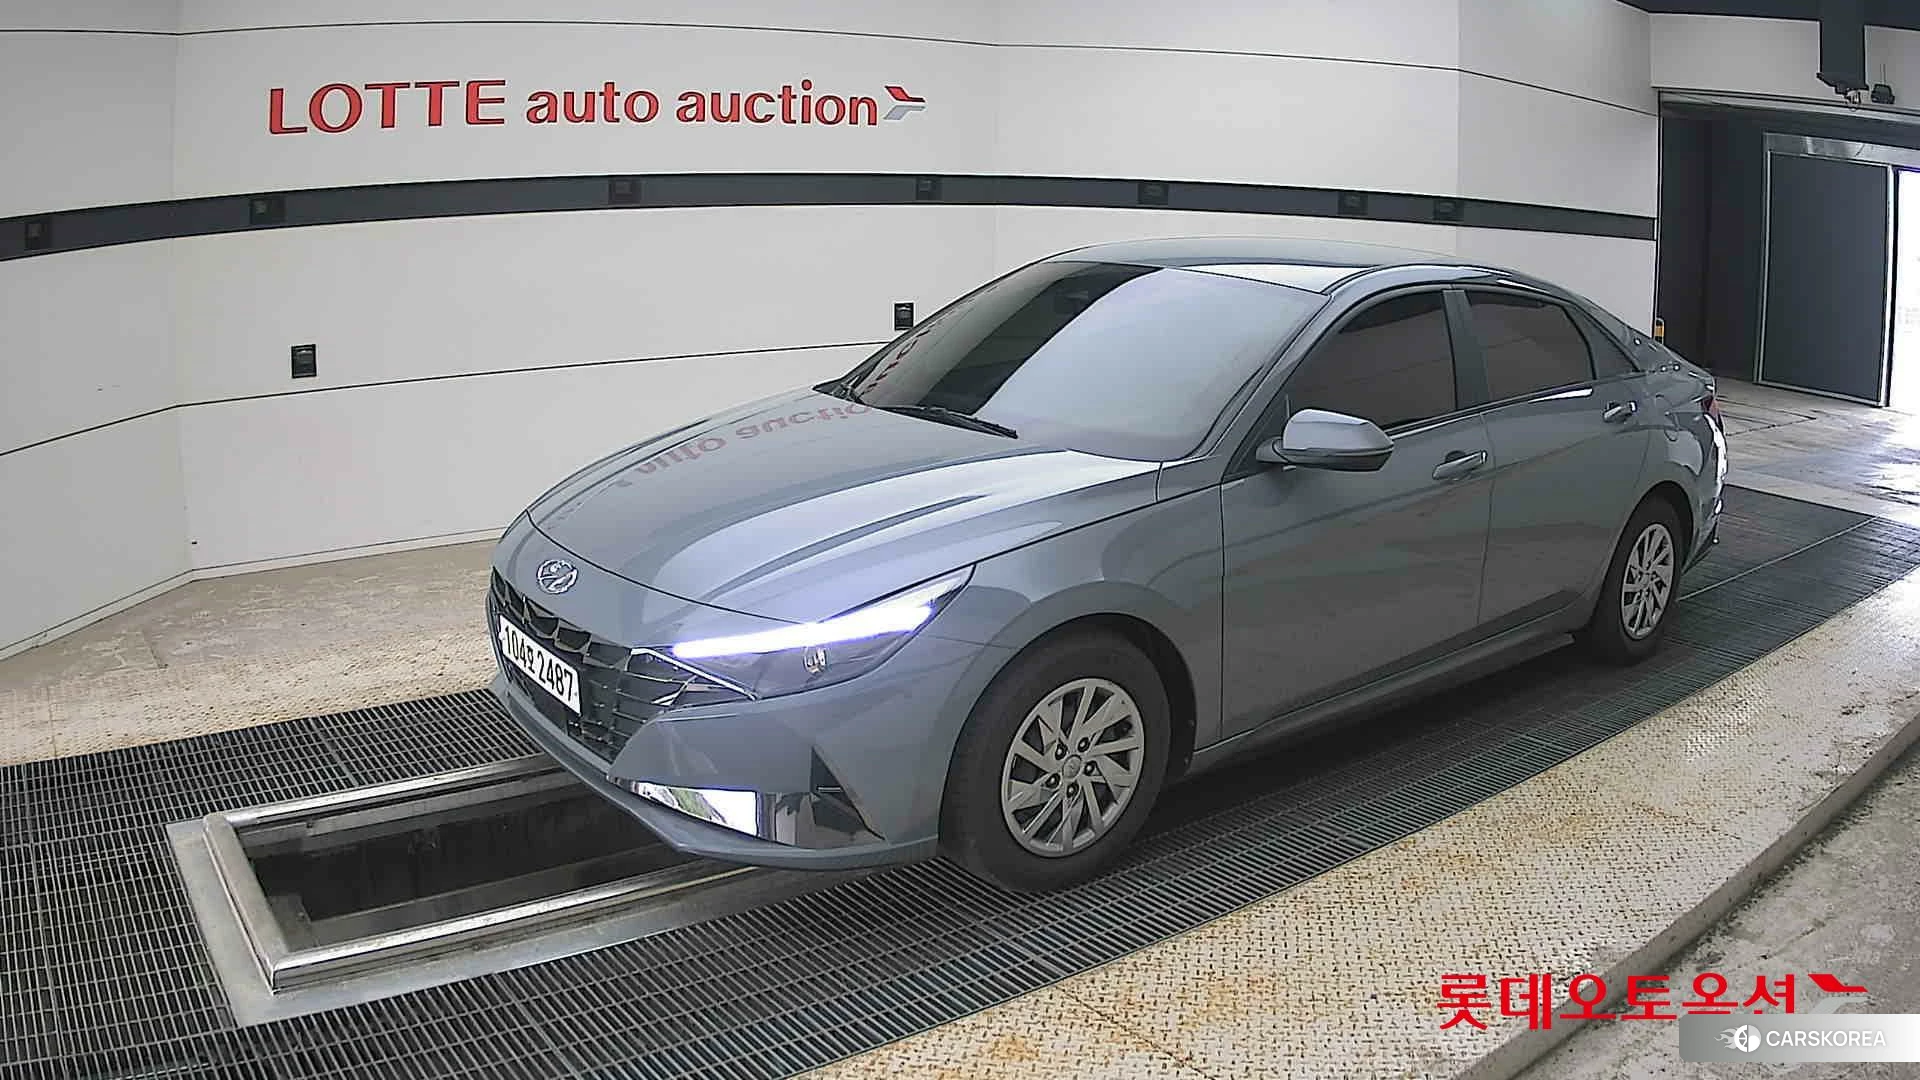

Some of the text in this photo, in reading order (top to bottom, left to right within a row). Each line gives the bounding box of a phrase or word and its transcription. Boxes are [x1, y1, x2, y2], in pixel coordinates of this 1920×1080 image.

[269, 79, 878, 136] LOTTE auto auction
[537, 650, 573, 702] 2487
